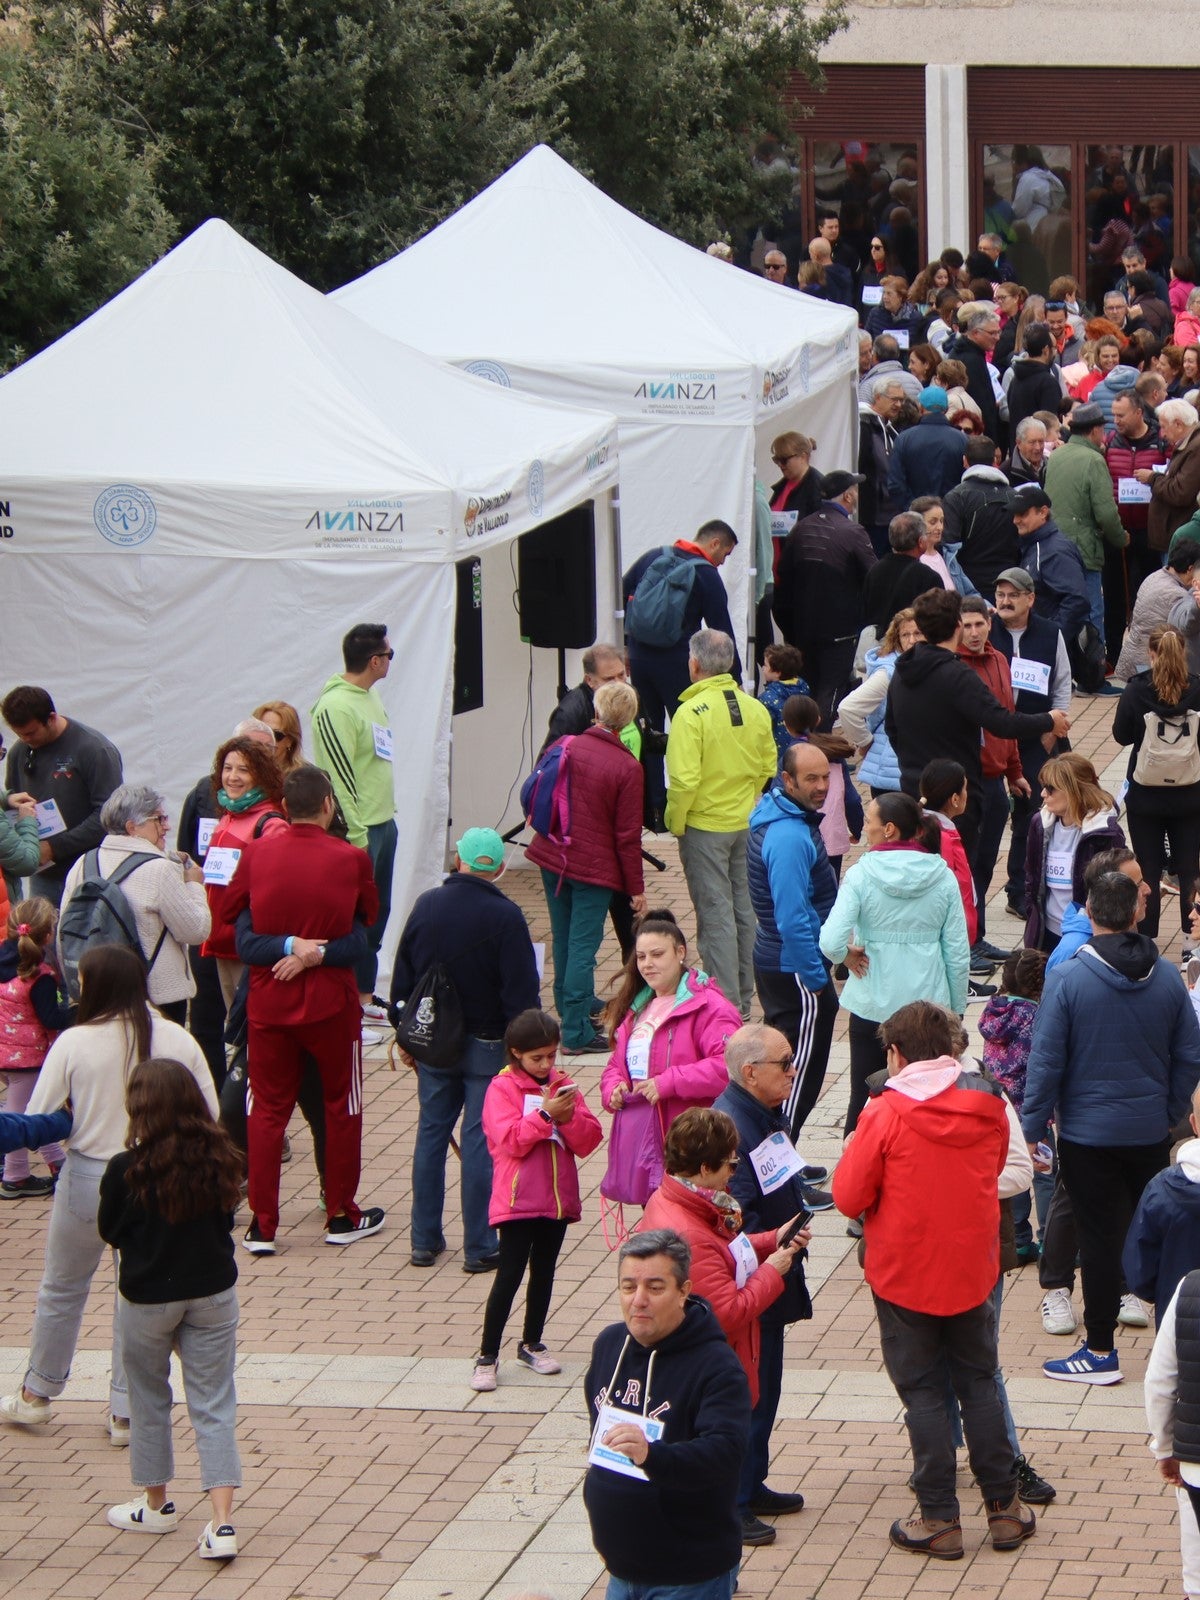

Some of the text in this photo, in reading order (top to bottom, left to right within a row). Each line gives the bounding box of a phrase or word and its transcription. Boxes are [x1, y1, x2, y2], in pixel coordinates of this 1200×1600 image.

[634, 382, 716, 400] AVANZA
[304, 510, 404, 532] AVANZA
[1013, 670, 1036, 682] 0123
